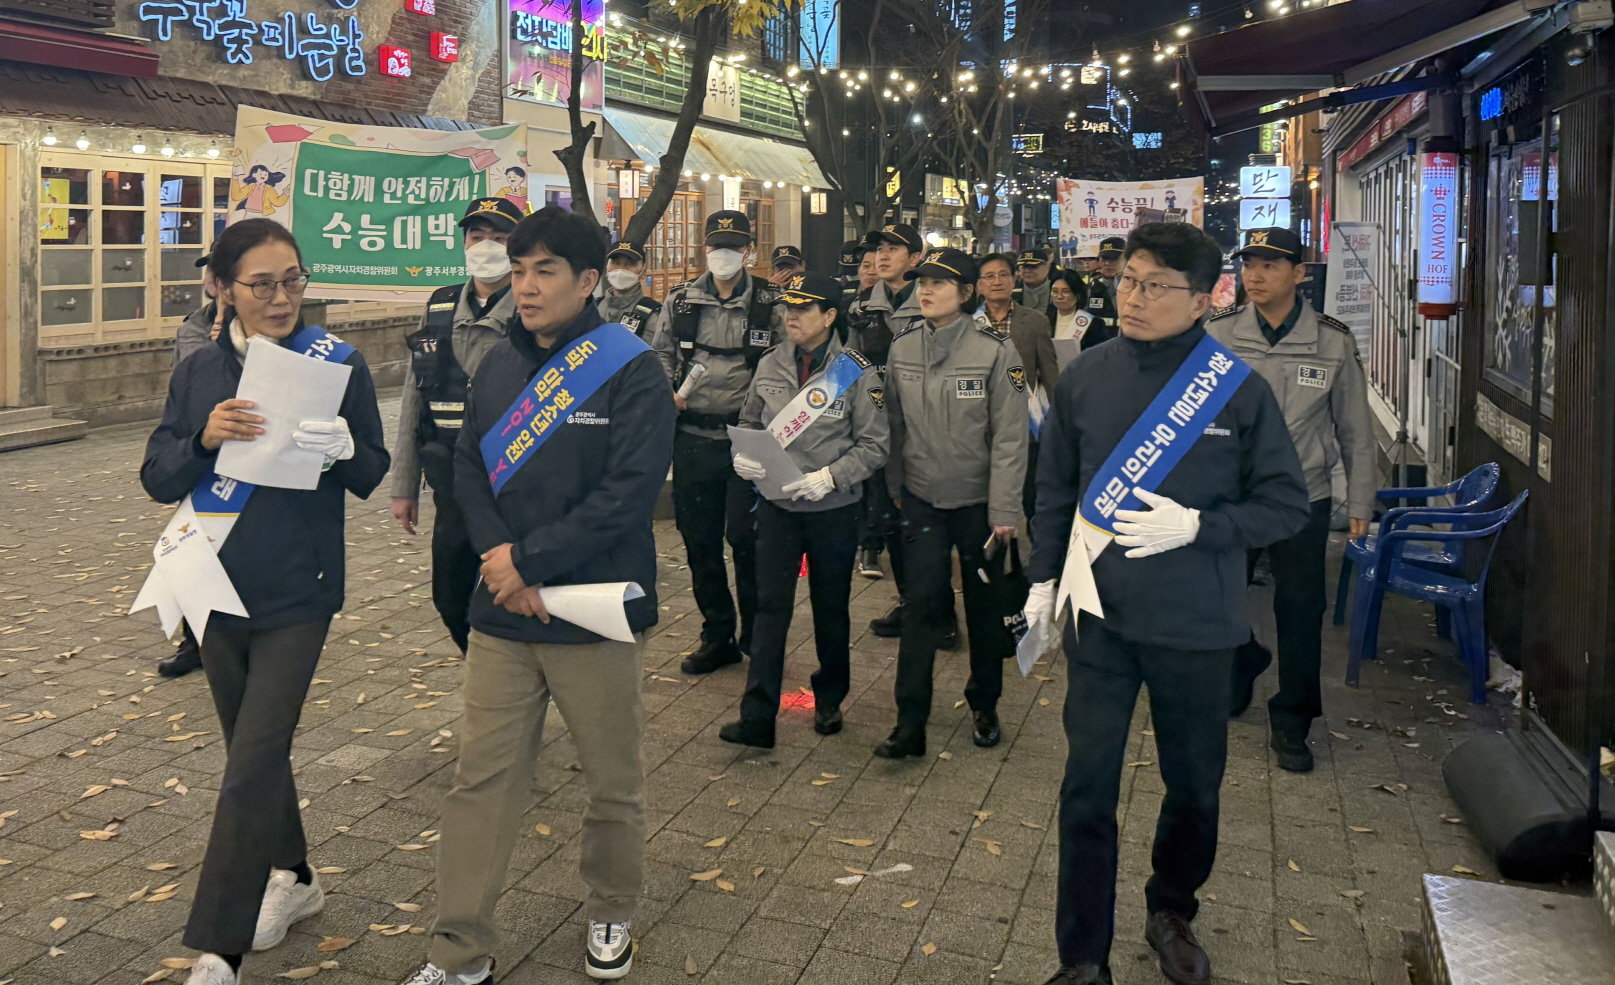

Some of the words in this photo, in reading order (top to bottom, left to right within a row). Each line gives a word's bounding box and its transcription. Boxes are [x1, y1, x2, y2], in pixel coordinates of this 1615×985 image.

[303, 168, 375, 203] 다함께
[382, 171, 481, 206] 안전하게!
[322, 211, 458, 251] 수능대박
[1431, 203, 1447, 261] CROWN
[312, 263, 398, 276] 광주광역시자치경찰위원회
[1427, 264, 1448, 274] HOF
[1168, 351, 1234, 427] 청소년은
[1300, 378, 1325, 387] POLICE
[501, 397, 535, 436] NO!
[530, 389, 575, 436] 청소년
[505, 429, 535, 464] 안전
[1120, 423, 1177, 484] 우리의
[1093, 476, 1130, 519] 미래
